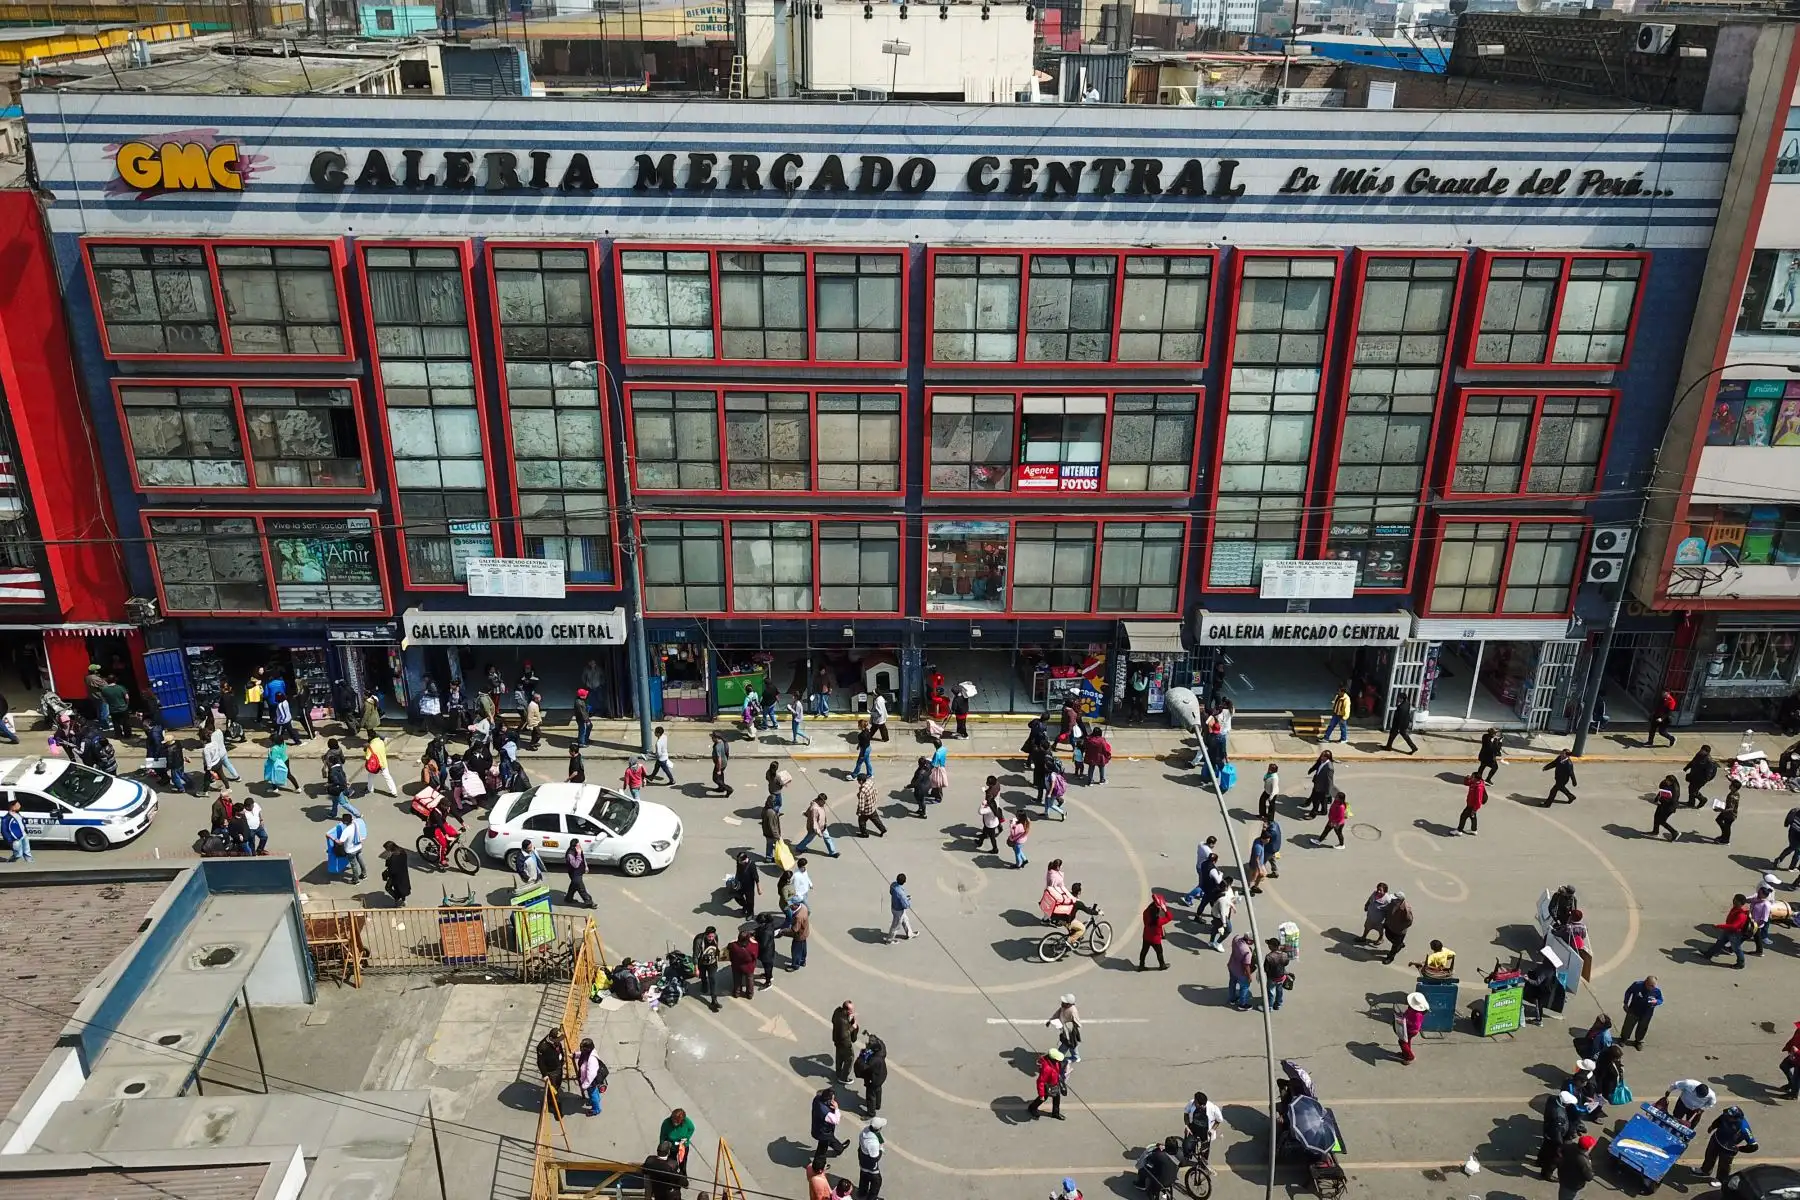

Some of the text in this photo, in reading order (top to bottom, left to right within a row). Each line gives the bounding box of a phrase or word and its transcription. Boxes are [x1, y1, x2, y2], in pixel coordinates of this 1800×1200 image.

[116, 141, 244, 192] GMC
[310, 149, 1247, 198] GALERIA MERCADO CENTRAL
[1279, 167, 1320, 192] La
[1330, 167, 1395, 194] Más
[1403, 167, 1510, 194] Grande
[1518, 168, 1571, 194] del
[1024, 466, 1055, 477] Agente
[1062, 466, 1099, 477] INTERNET
[1061, 479, 1098, 490] FOTOS
[272, 521, 291, 530] Vive
[292, 521, 301, 530] la
[328, 543, 370, 562] Amir
[412, 625, 614, 639] GALERIA MERCADO CENTRAL
[1209, 625, 1401, 640] GALERIA MERCADO CENTRAL
